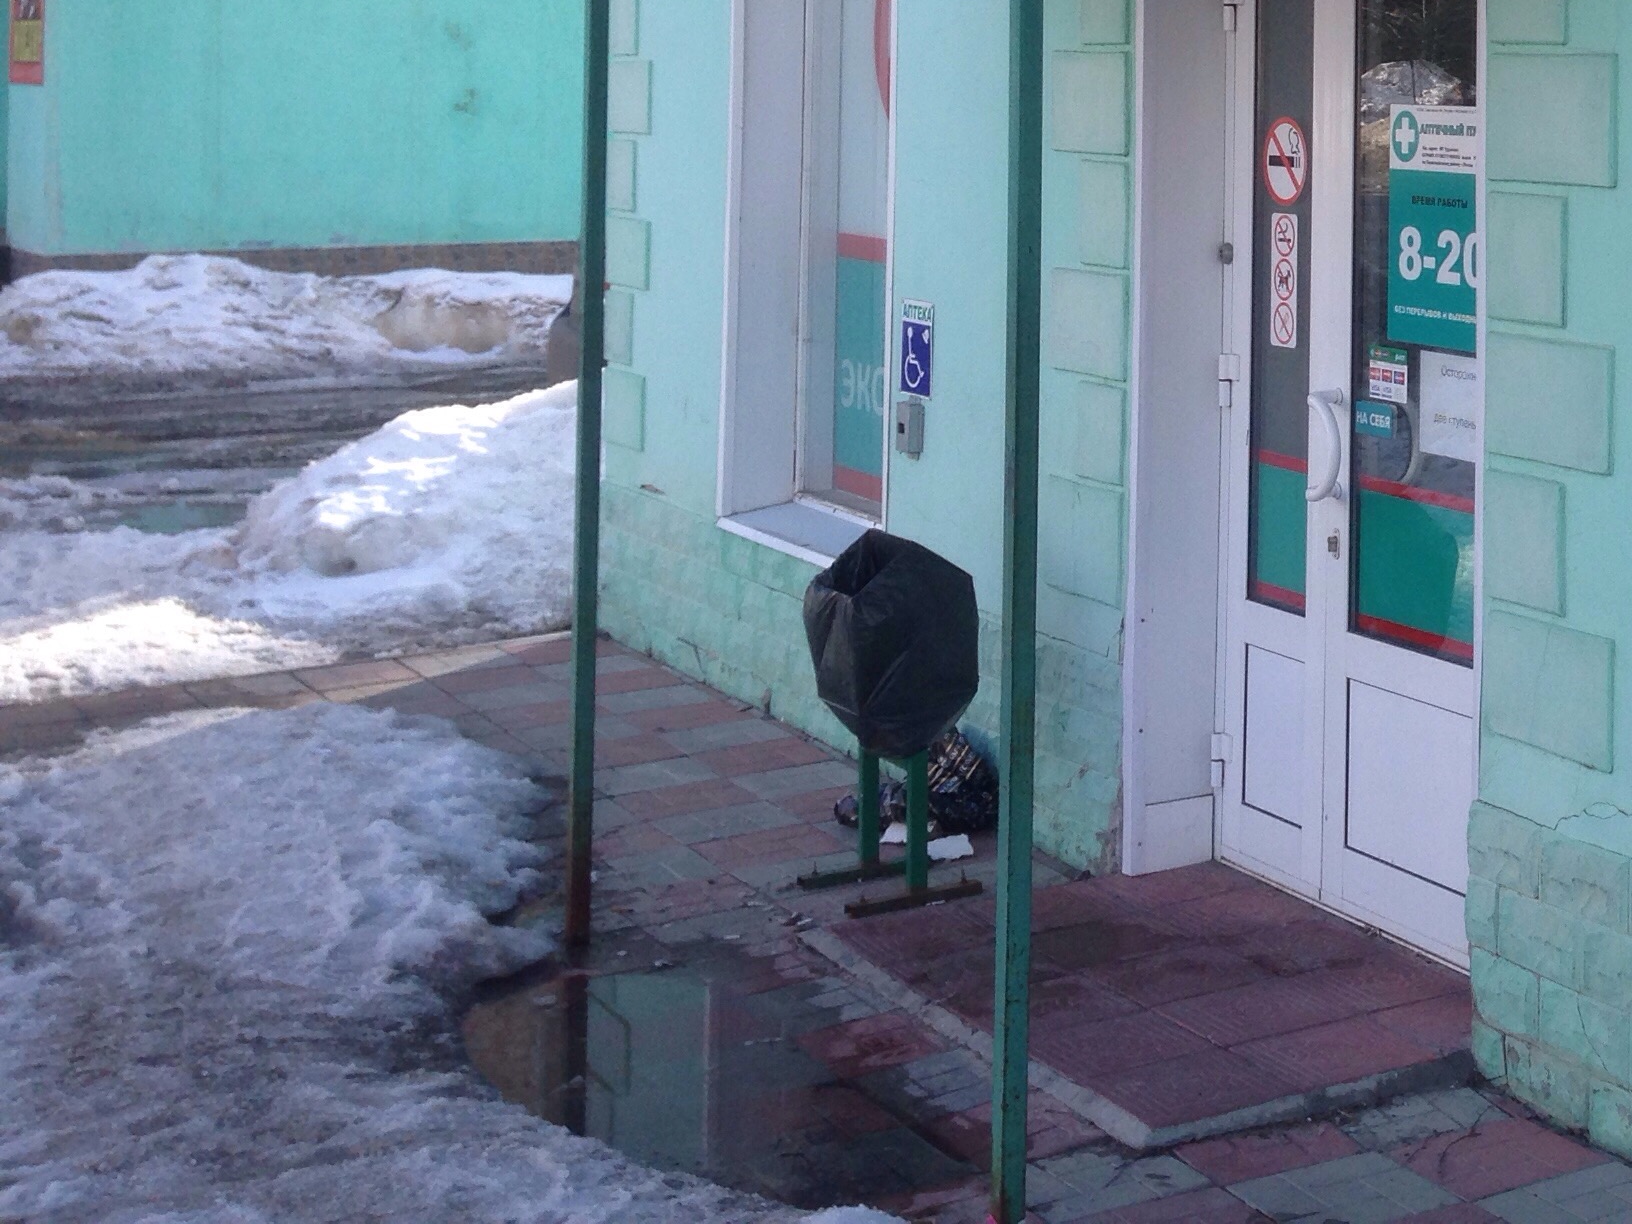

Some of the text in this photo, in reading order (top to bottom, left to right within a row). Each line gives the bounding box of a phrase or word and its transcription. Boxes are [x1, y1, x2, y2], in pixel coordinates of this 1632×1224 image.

[1412, 195, 1468, 208] ВРЕМЯ РАБОТЫ
[903, 304, 932, 322] АПТЕКА
[1395, 305, 1406, 314] БЕЗ
[1356, 411, 1391, 429] НА СЕБЯ
